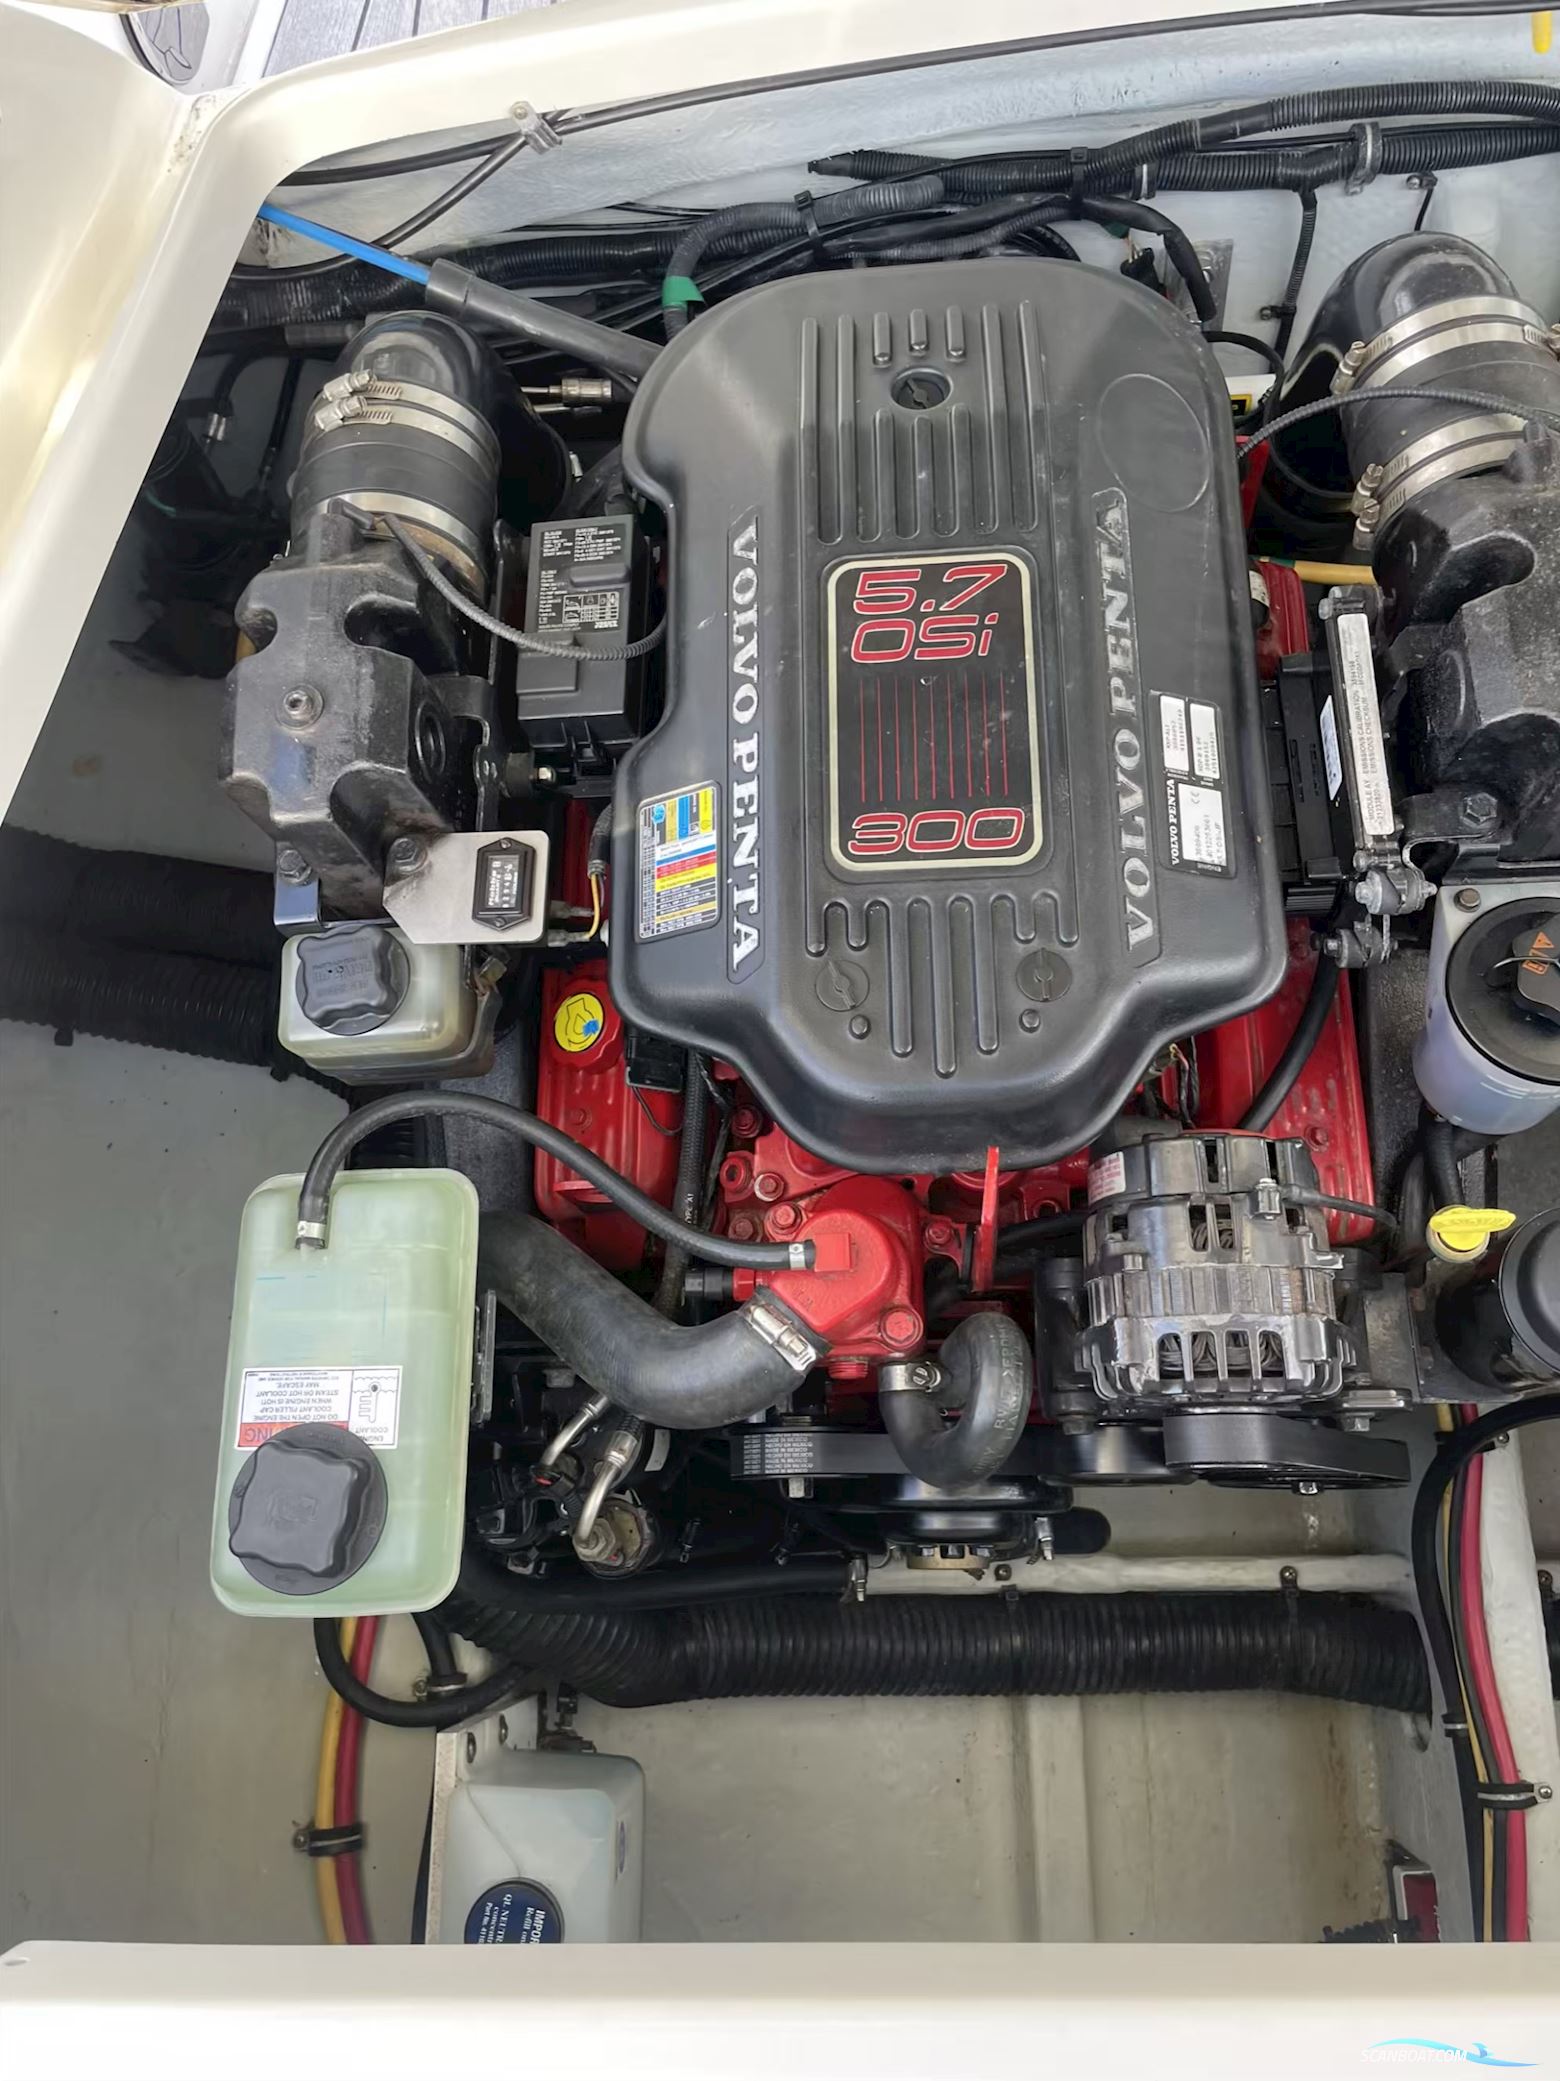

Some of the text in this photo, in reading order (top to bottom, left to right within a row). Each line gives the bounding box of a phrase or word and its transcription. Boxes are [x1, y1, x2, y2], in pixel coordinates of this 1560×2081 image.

[853, 564, 1008, 615] 5.7
[733, 515, 760, 971] VOLVO PENTA
[1097, 500, 1155, 952] VOLVO PENTA
[1166, 779, 1179, 826] PENTA
[848, 807, 1025, 856] 300
[1169, 826, 1180, 865] VOLVO
[312, 1397, 332, 1405] WHEN
[487, 1906, 499, 1944] concentr
[496, 1909, 510, 1943] NEUTR
[523, 1906, 535, 1930] Refill
[530, 1909, 546, 1944] IMPOR
